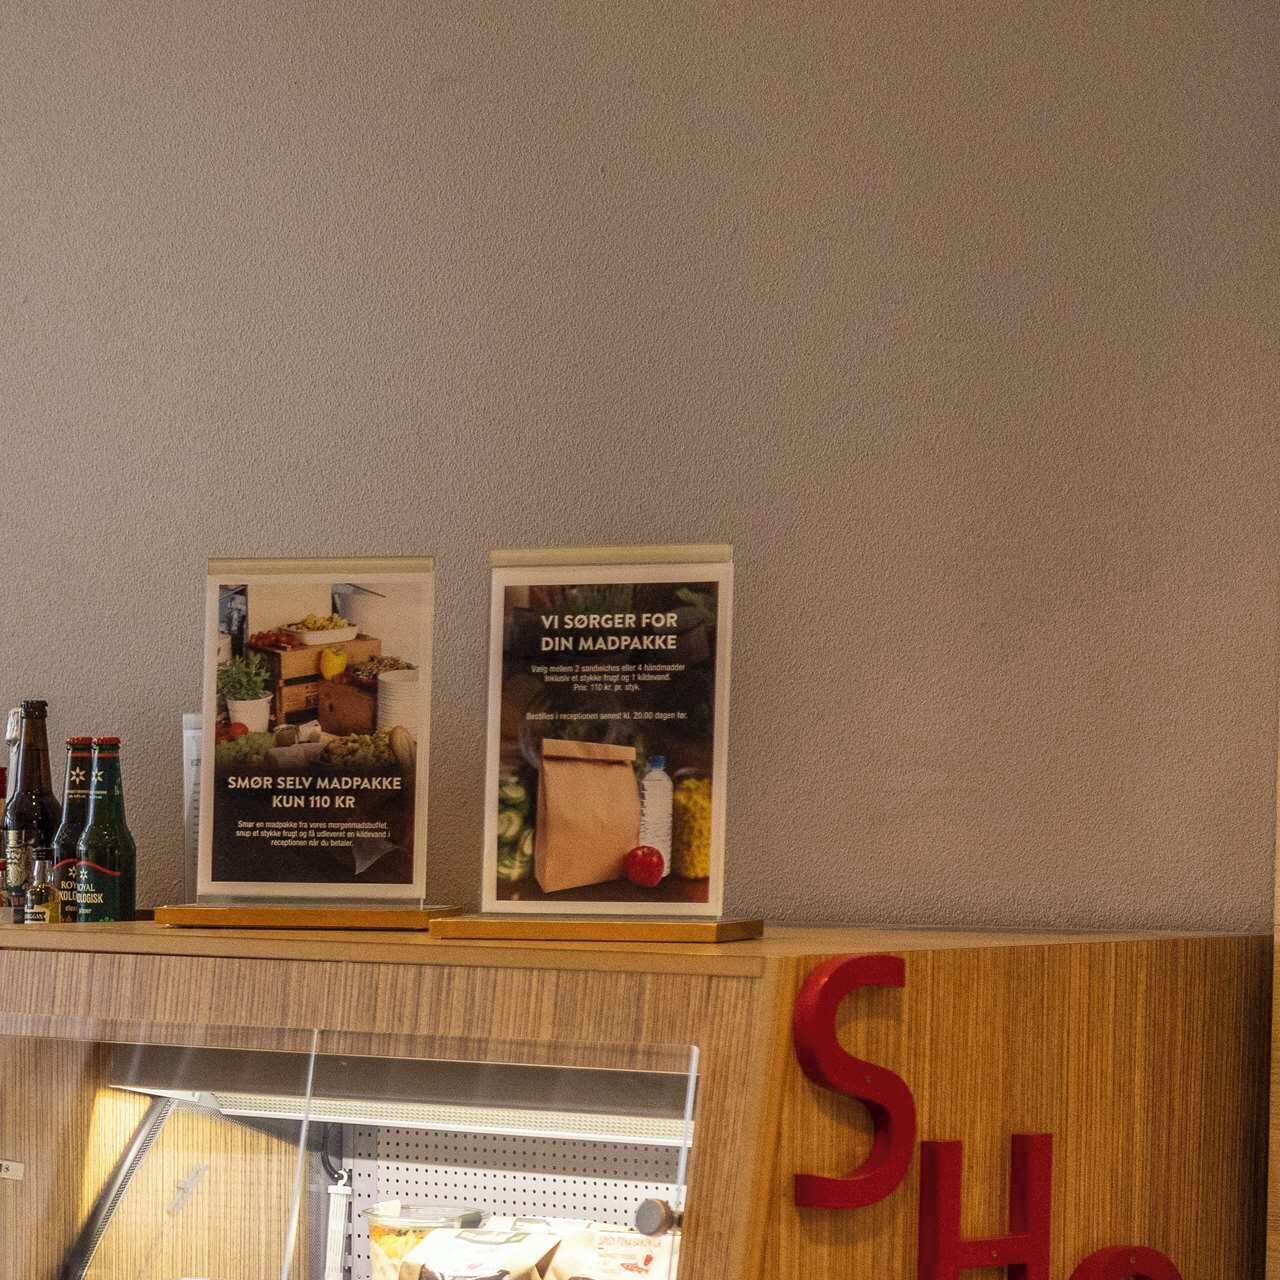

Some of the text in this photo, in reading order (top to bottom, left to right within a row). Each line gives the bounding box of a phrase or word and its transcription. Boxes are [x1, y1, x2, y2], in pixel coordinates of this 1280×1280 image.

[541, 613, 678, 629] VI SØRGER FOR
[541, 635, 677, 651] DIN MADPAKKE
[228, 776, 402, 790] SMØR SELV MADPAKKE
[272, 795, 356, 808] KUN 110 KR
